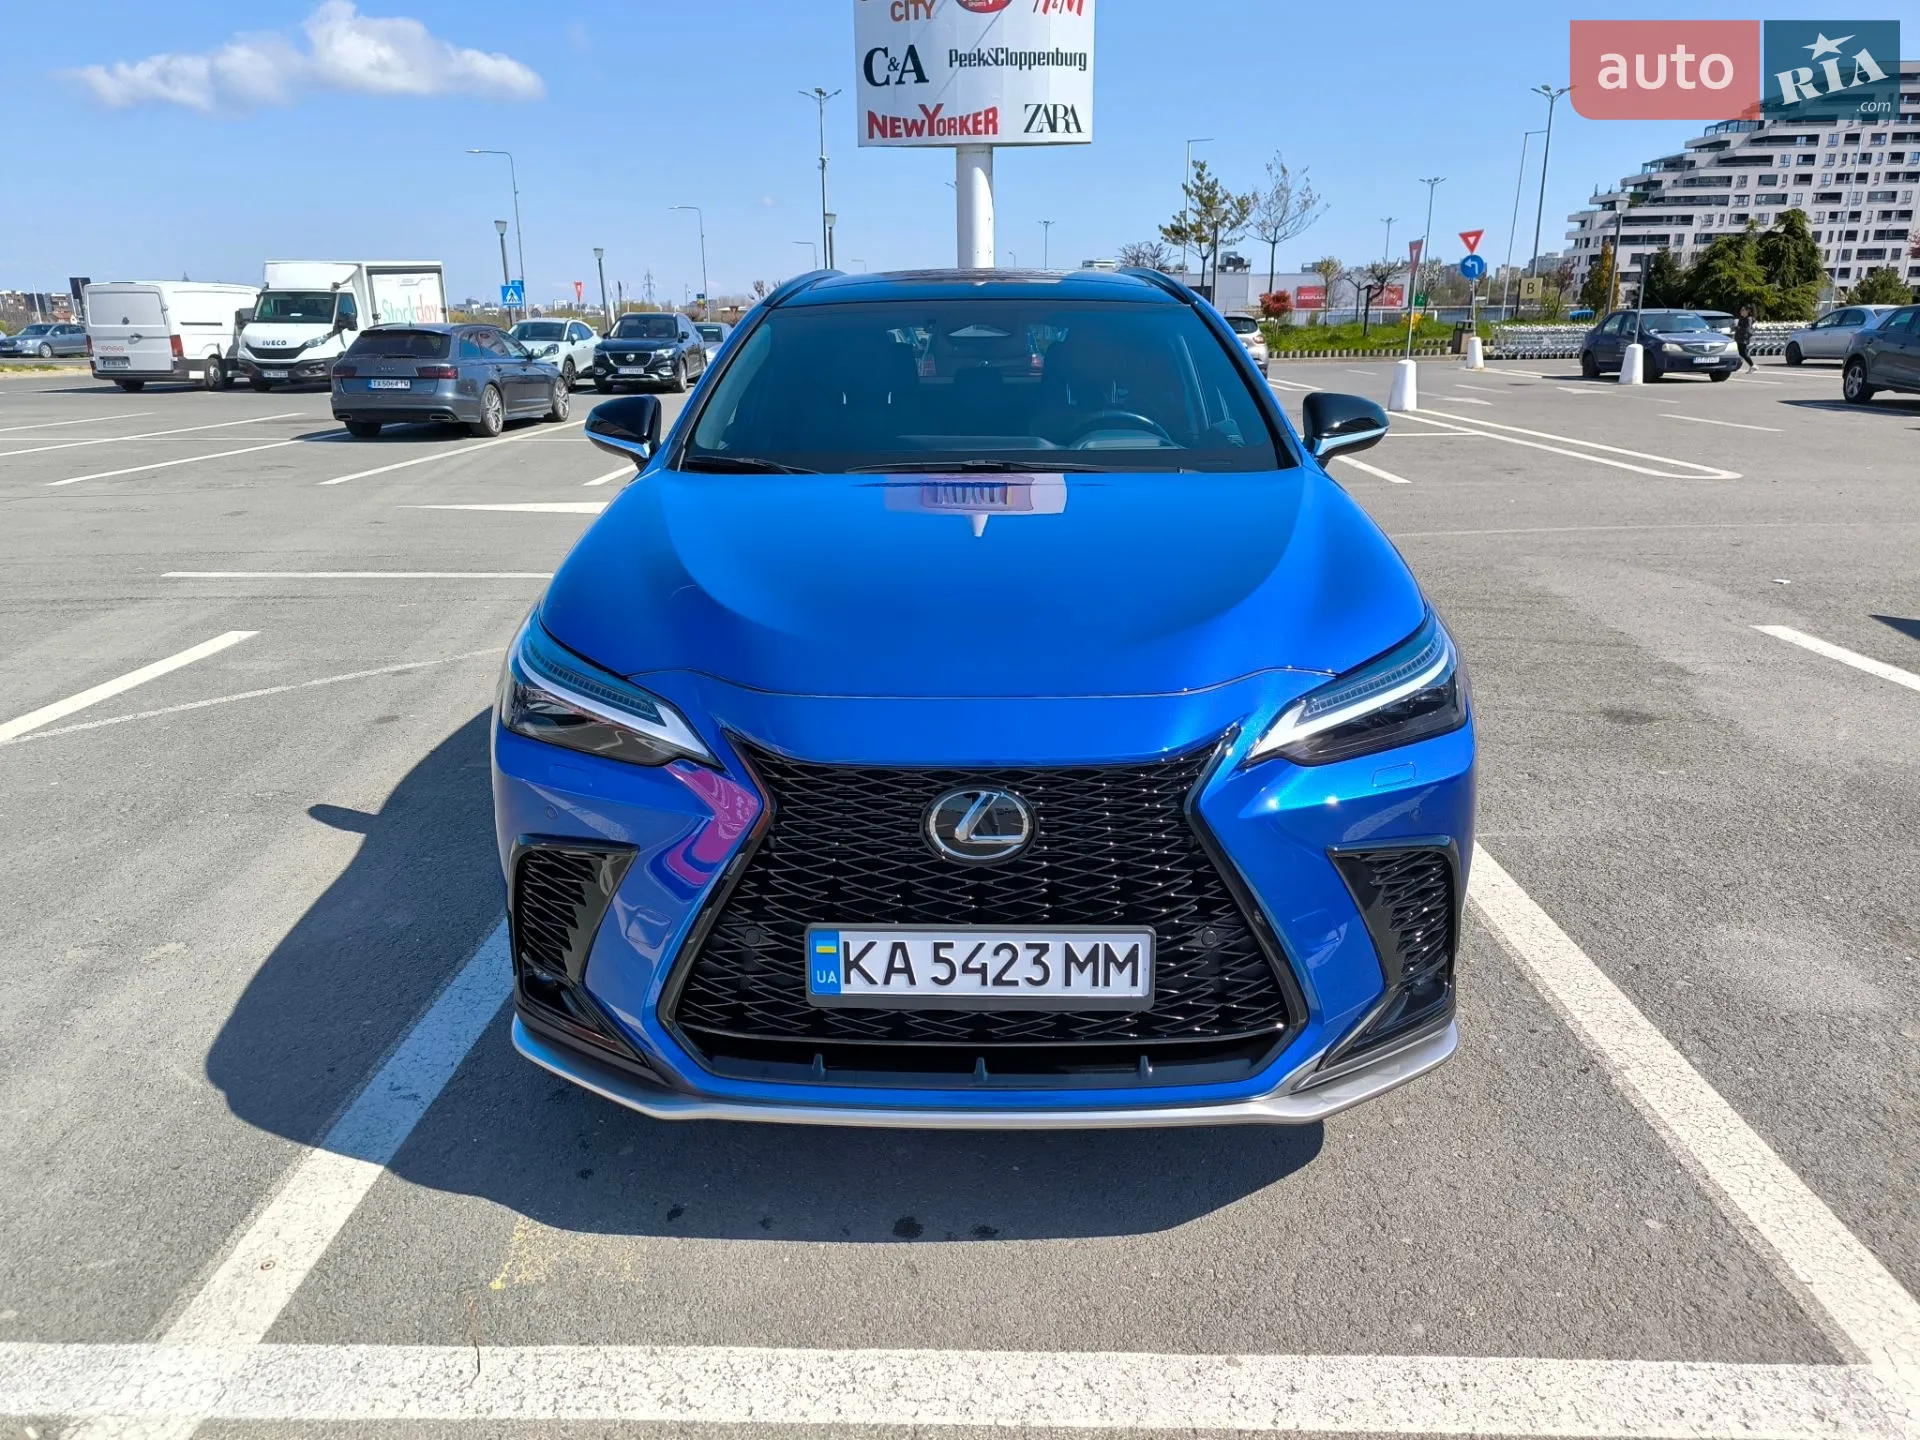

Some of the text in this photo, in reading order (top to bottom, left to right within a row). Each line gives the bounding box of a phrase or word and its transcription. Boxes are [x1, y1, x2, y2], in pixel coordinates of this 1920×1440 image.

[890, 0, 935, 22] CITY
[863, 44, 929, 87] C&A
[1024, 103, 1085, 134] ZARA
[1527, 282, 1535, 294] B
[816, 969, 838, 985] UA
[843, 940, 1140, 988] KA 5423 MM
